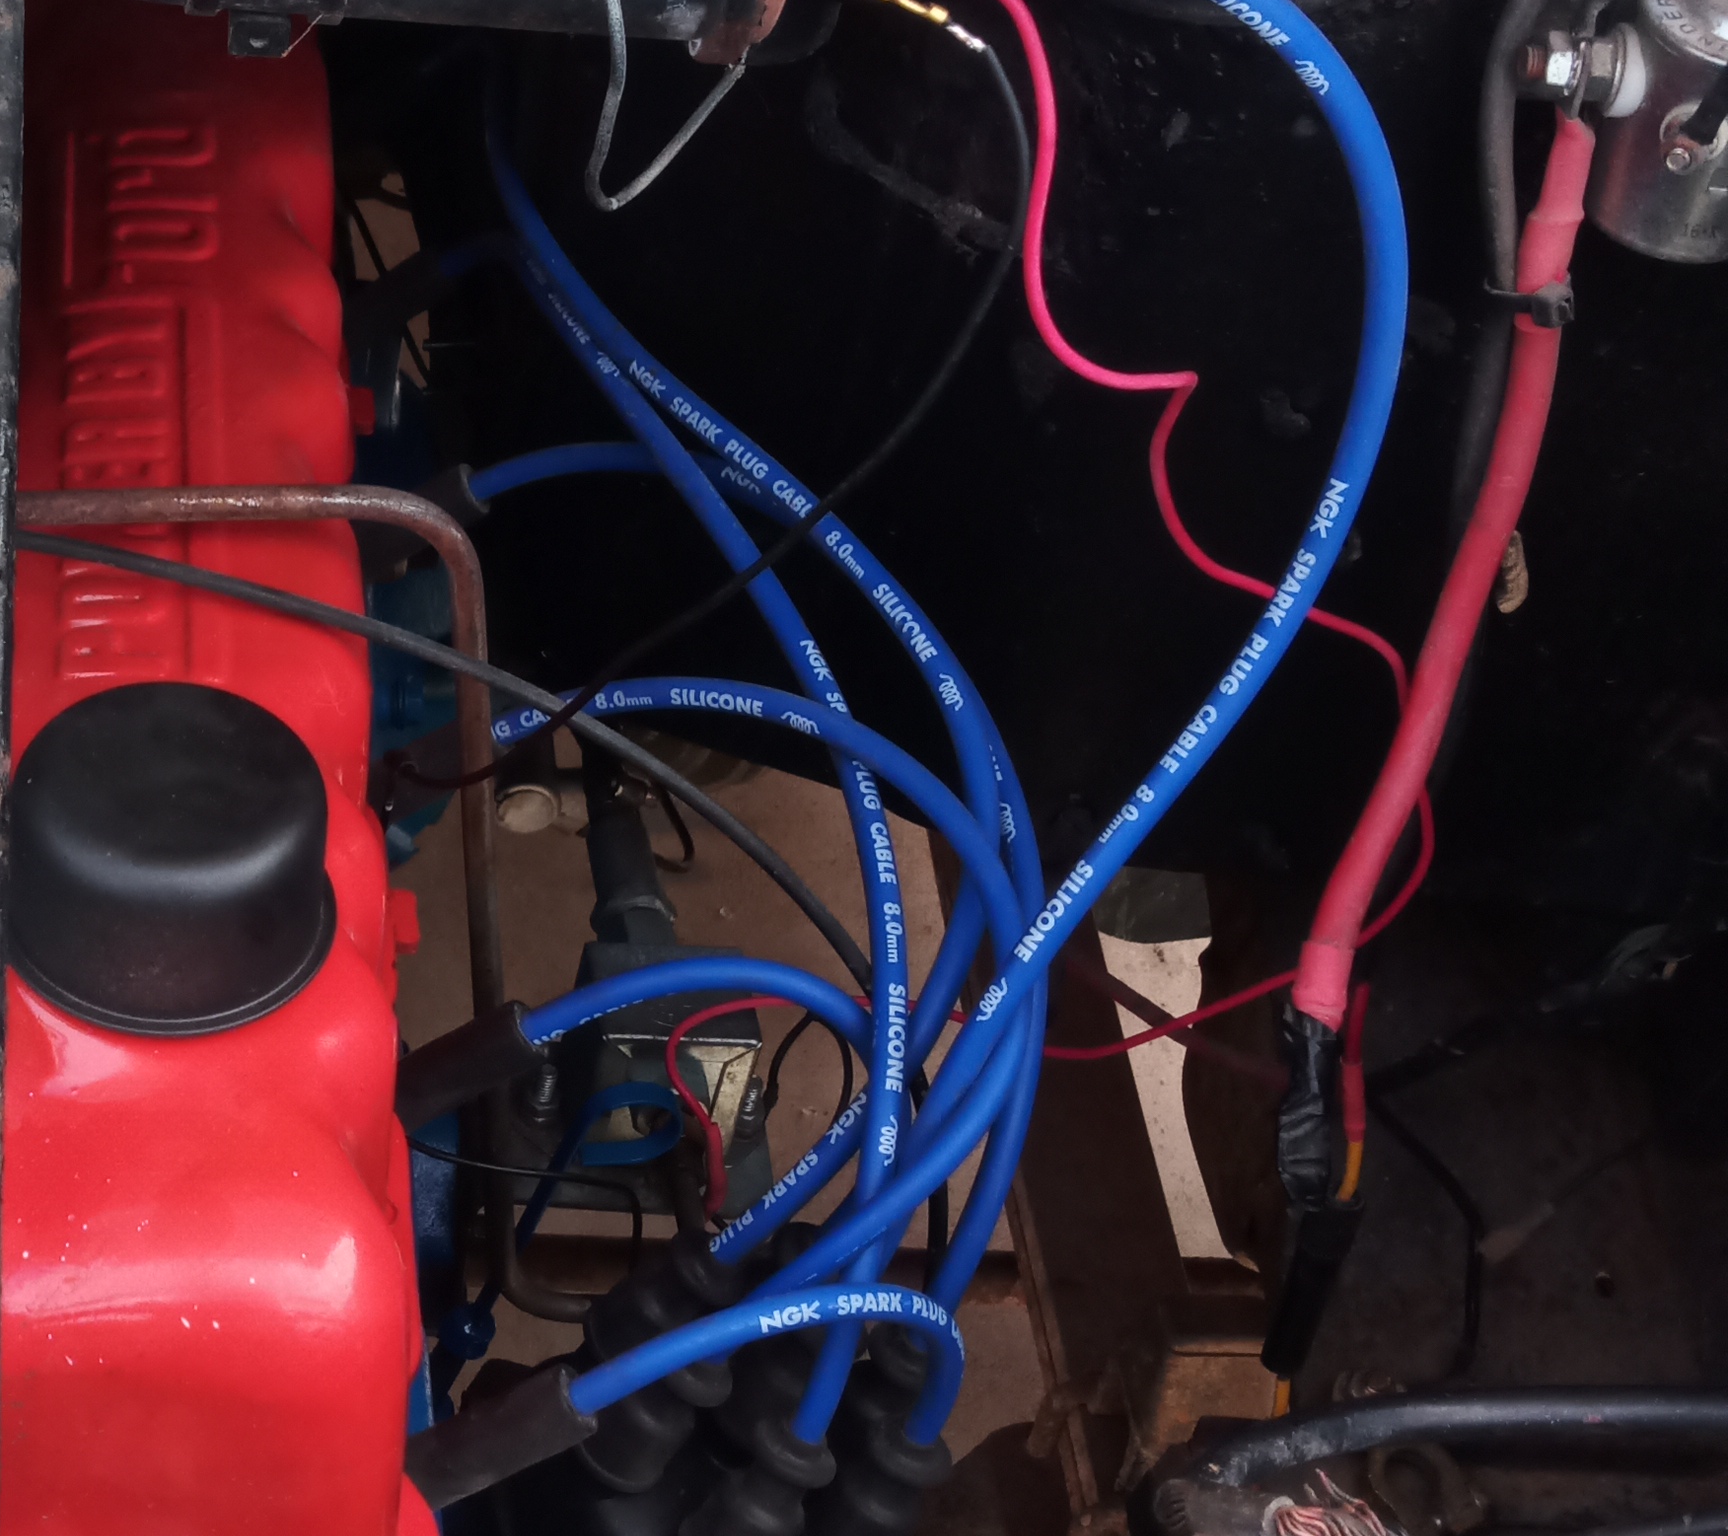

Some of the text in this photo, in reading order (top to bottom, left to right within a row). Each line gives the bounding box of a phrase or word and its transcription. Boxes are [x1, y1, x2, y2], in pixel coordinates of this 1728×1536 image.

[628, 359, 939, 664] NGK SPARK PLUG CABL 8.0mm SILICONE
[1308, 476, 1351, 540] NGK
[1263, 547, 1318, 629] SPARK
[799, 638, 834, 682] NGK
[1218, 632, 1270, 697] PLUG
[594, 687, 765, 719] 8.0mm SILICONE
[1158, 703, 1218, 775] CABLE
[869, 821, 898, 885] CABLE
[883, 901, 903, 964] 8.0mm
[1013, 859, 1095, 964] SILICONE
[884, 981, 907, 1094] SILICONE
[825, 1091, 868, 1145] NGK
[761, 1148, 820, 1211] SPARK
[758, 1291, 949, 1334] NGK SPARK PLUG
